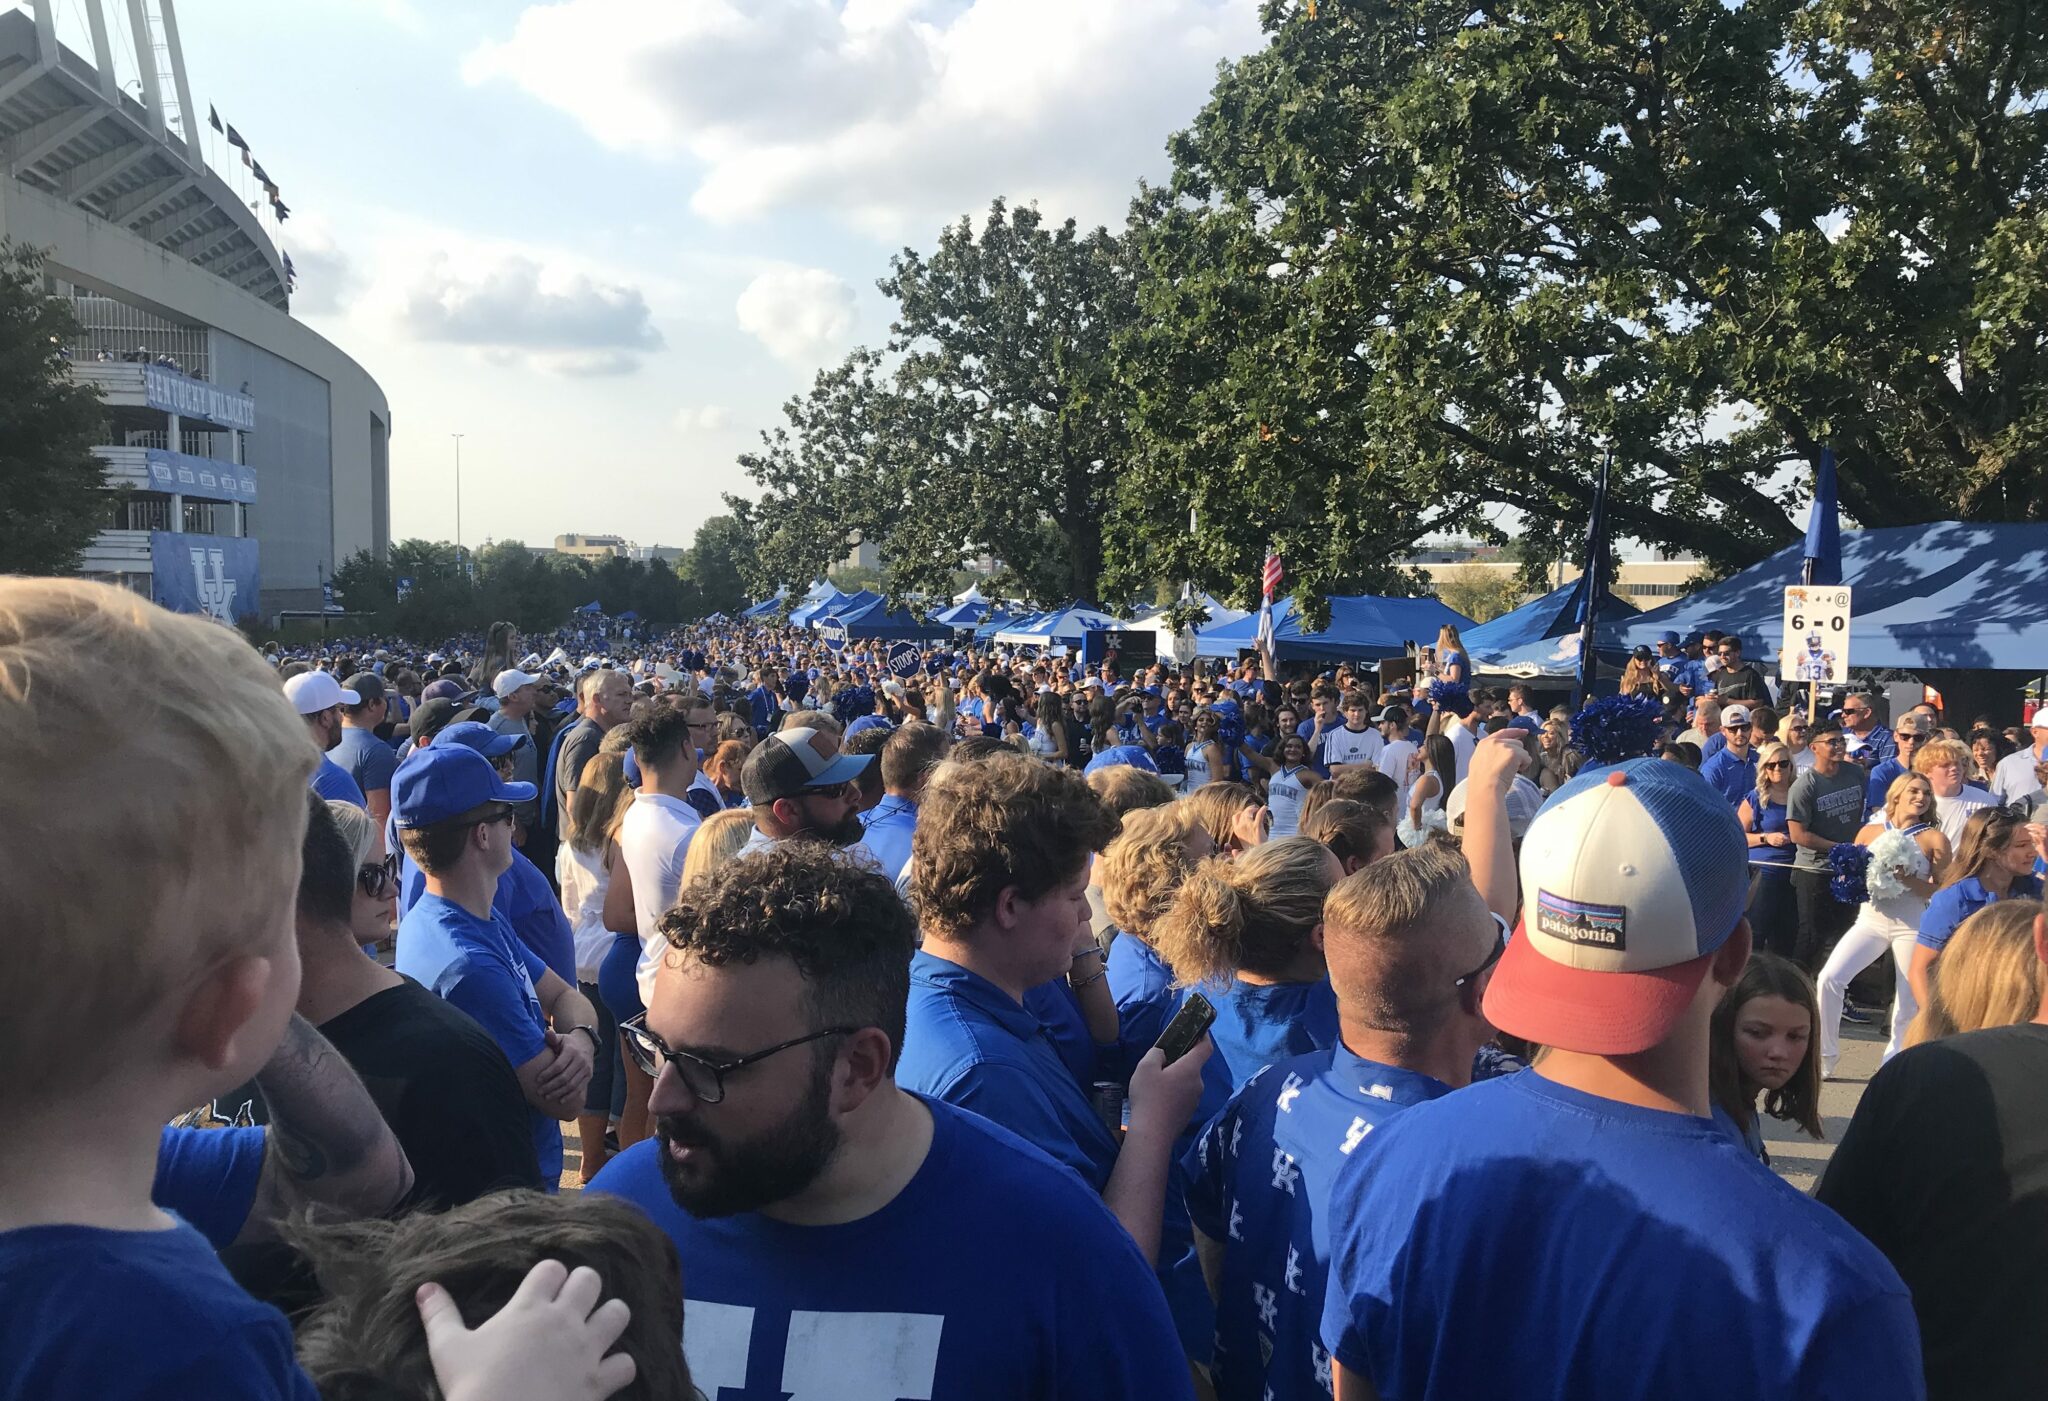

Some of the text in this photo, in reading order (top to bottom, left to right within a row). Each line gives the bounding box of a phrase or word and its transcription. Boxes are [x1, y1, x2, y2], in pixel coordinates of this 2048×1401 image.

[147, 371, 254, 427] KENTUCKY WILDCATS
[190, 547, 237, 626] UK
[822, 625, 845, 642] STOOPS
[1791, 614, 1805, 630] 6
[1831, 616, 1845, 631] 0
[1105, 634, 1122, 649] UK
[889, 647, 920, 673] STOOPS
[1804, 665, 1822, 680] 13
[1817, 785, 1862, 811] KENTUCKY
[1541, 916, 1616, 943] patagonia
[1271, 1147, 1299, 1197] UK
